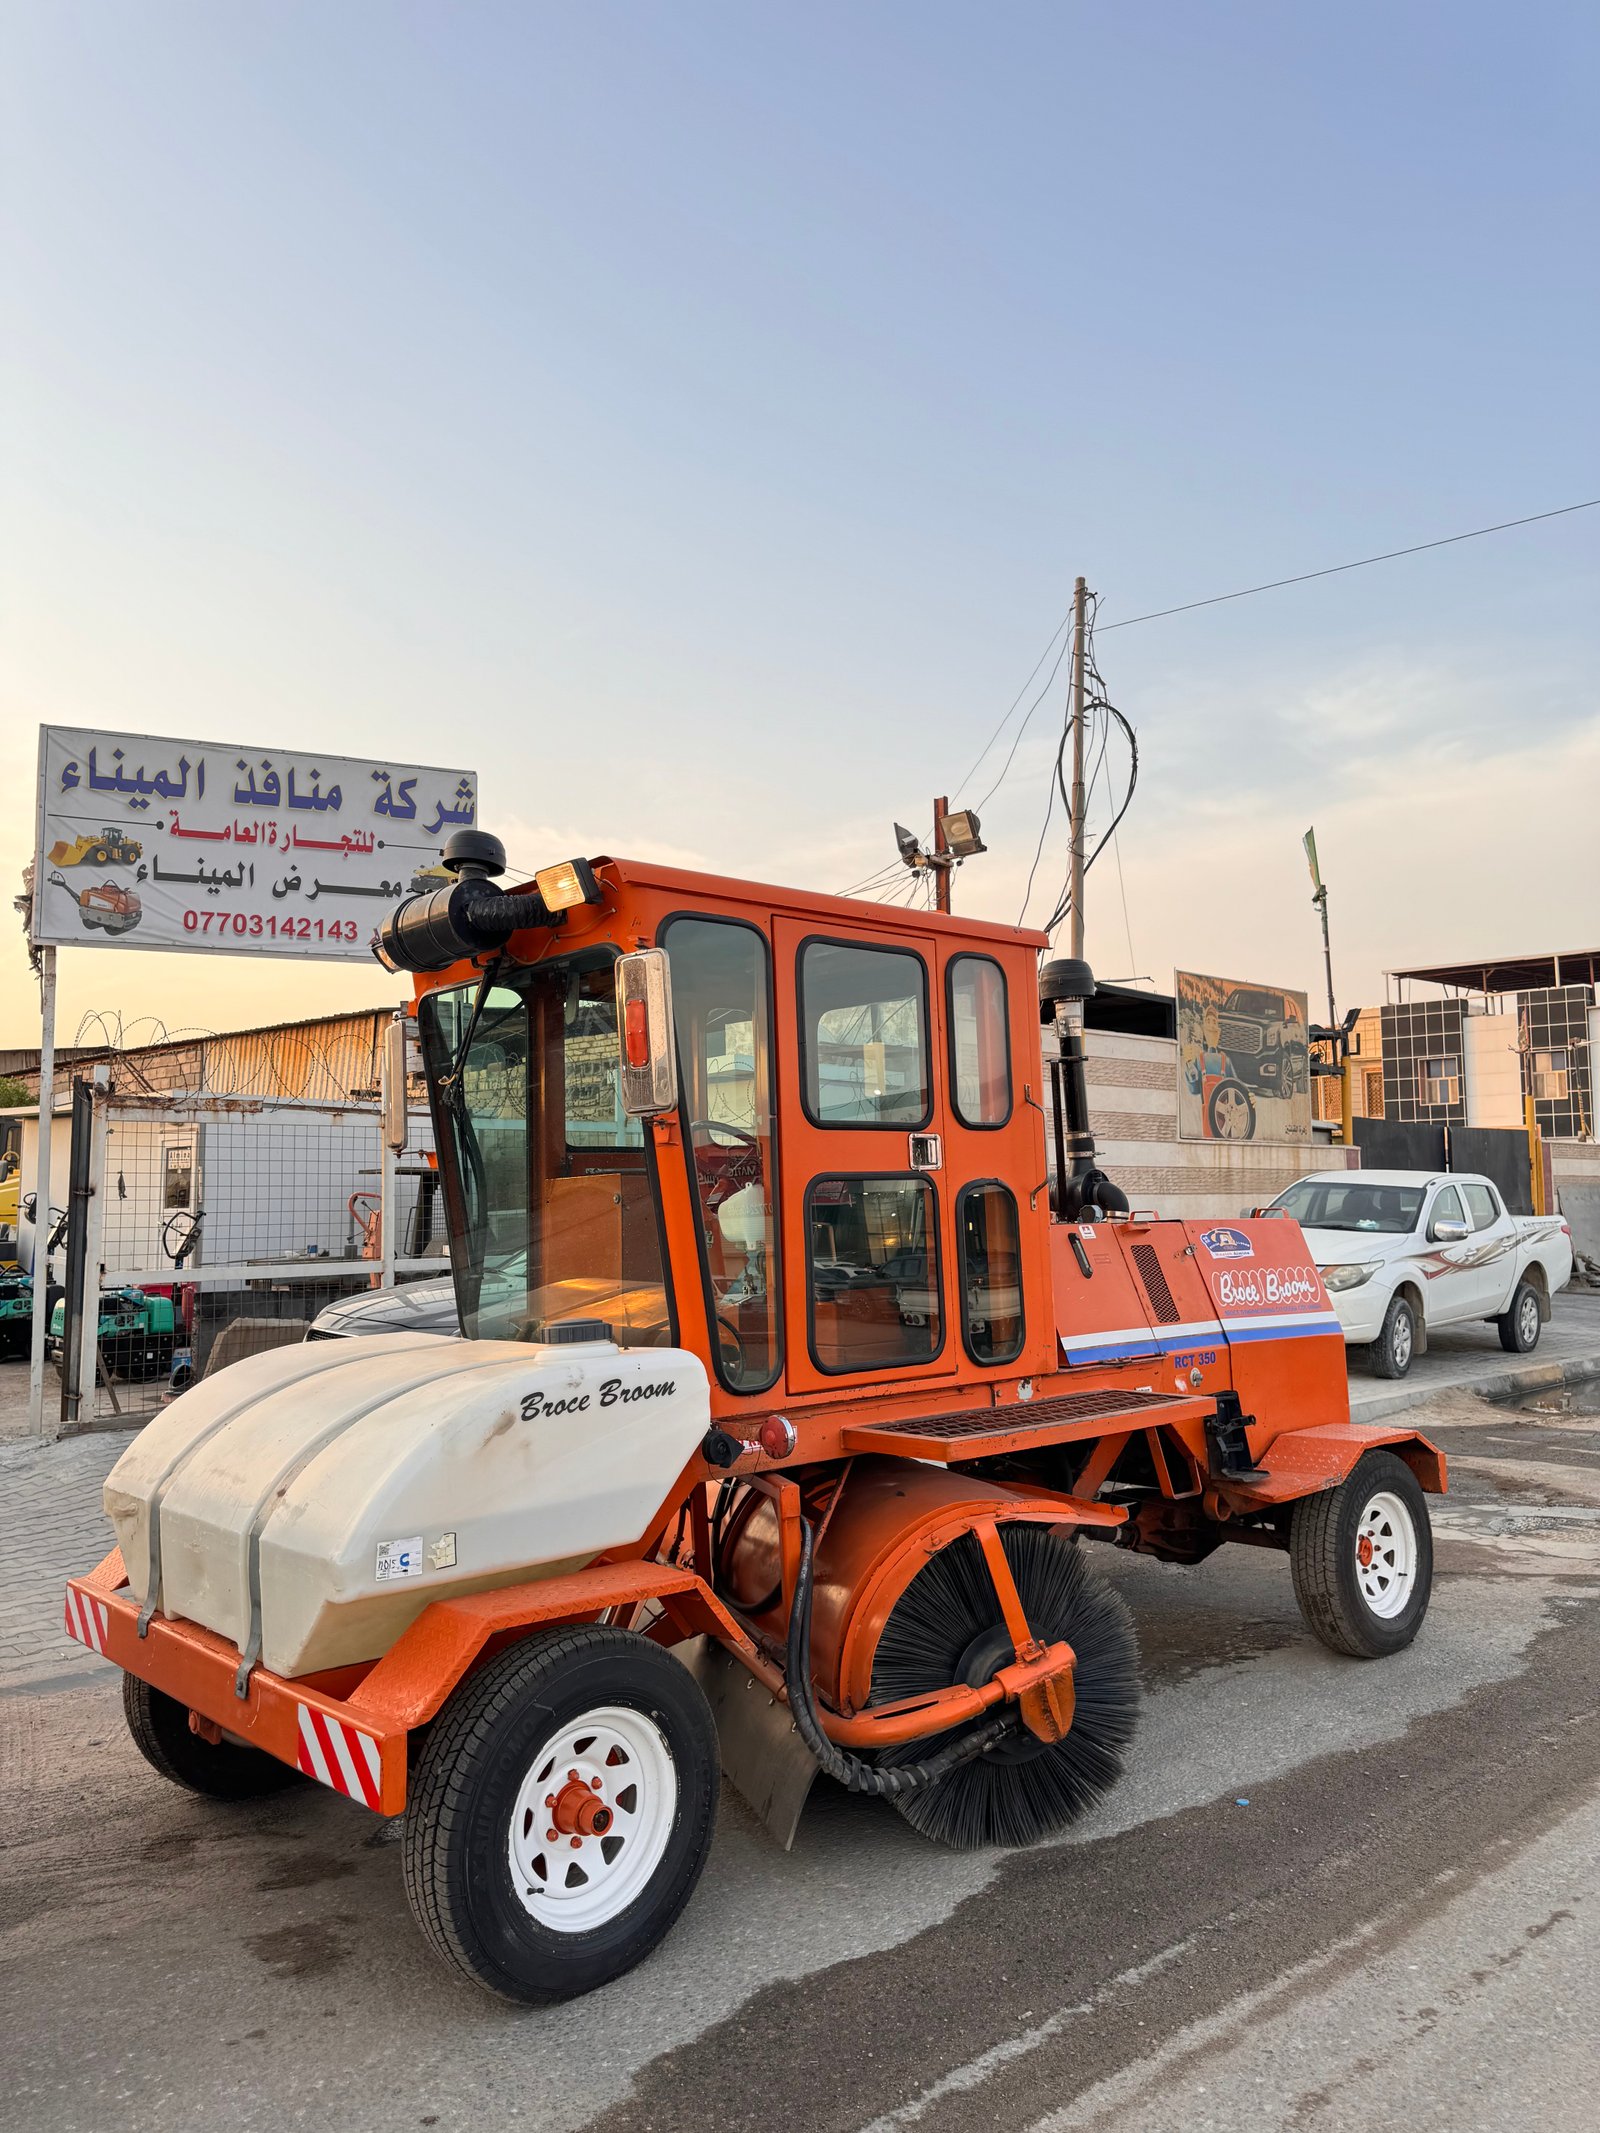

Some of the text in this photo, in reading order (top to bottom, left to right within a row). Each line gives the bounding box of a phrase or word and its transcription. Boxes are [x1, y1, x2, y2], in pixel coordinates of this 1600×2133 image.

[60, 746, 476, 835] شركة منافذ الميناء
[168, 809, 375, 859] للتجارة العامة
[135, 854, 403, 899] معرض الميناء
[183, 908, 359, 941] 07703142143
[1220, 1274, 1316, 1303] Broce Broom
[1174, 1351, 1216, 1368] RCT 350
[520, 1378, 677, 1421] Broce Broom
